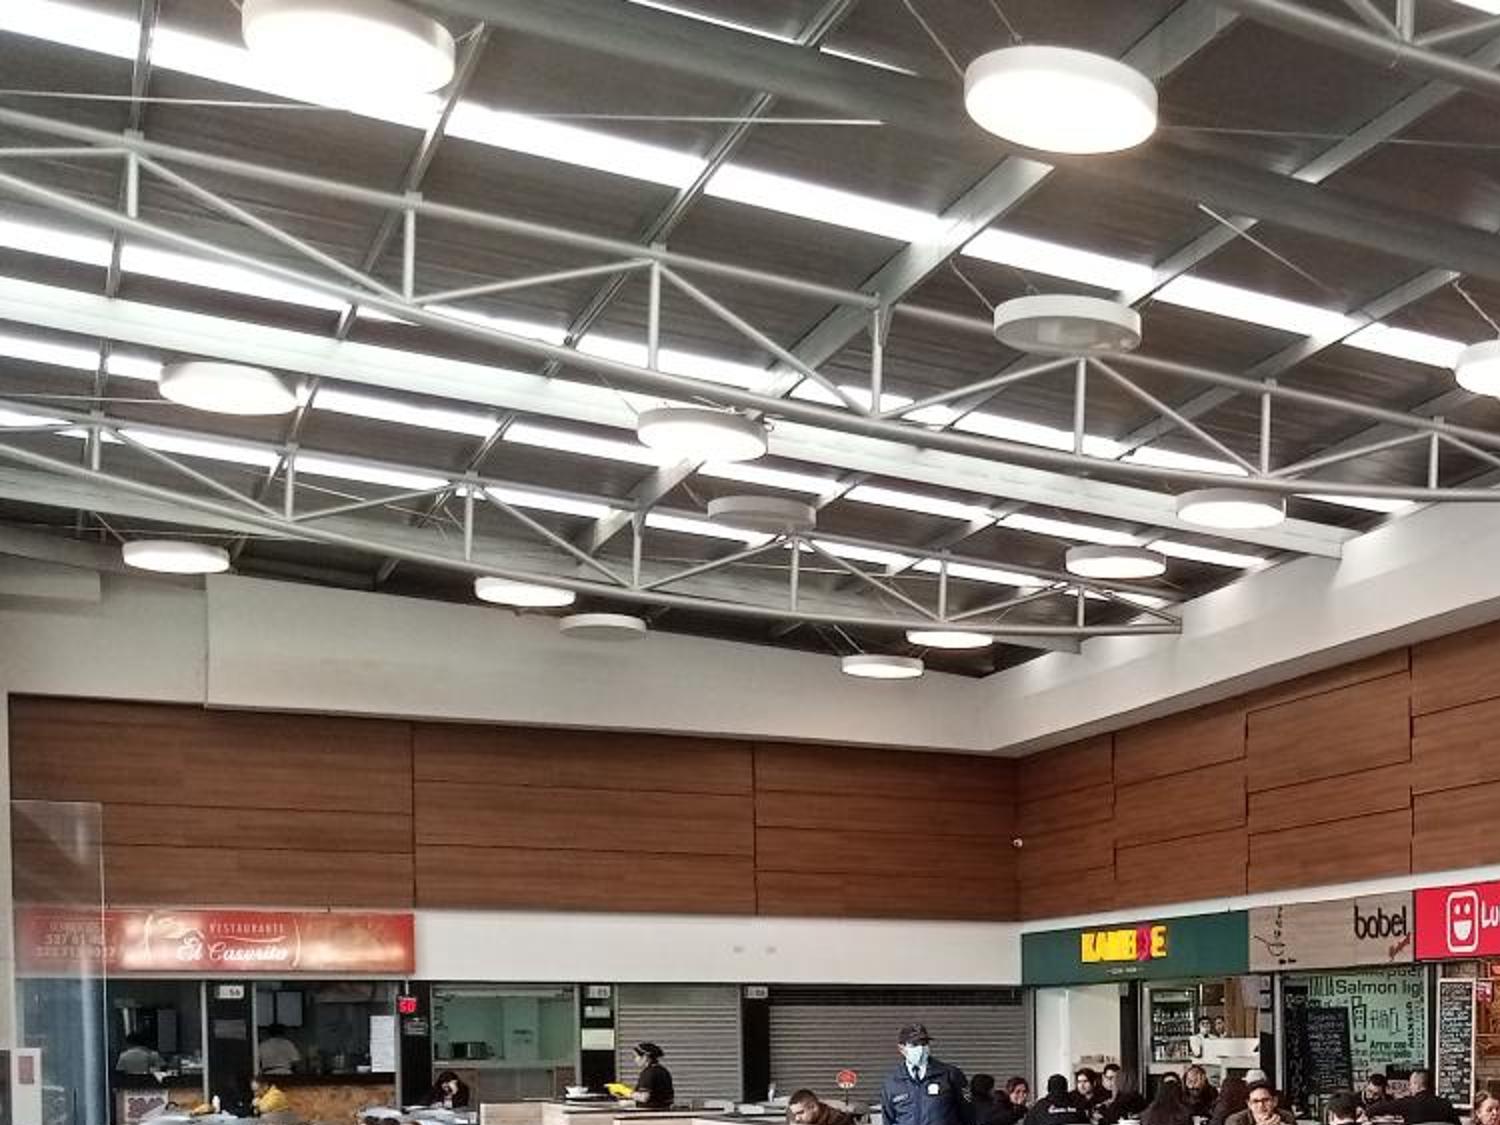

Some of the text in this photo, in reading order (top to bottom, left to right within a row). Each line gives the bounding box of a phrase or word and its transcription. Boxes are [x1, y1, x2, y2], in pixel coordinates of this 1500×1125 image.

[209, 922, 285, 934] RESTAURANTE
[1354, 905, 1407, 940] babel
[1336, 979, 1398, 995] Salmon
